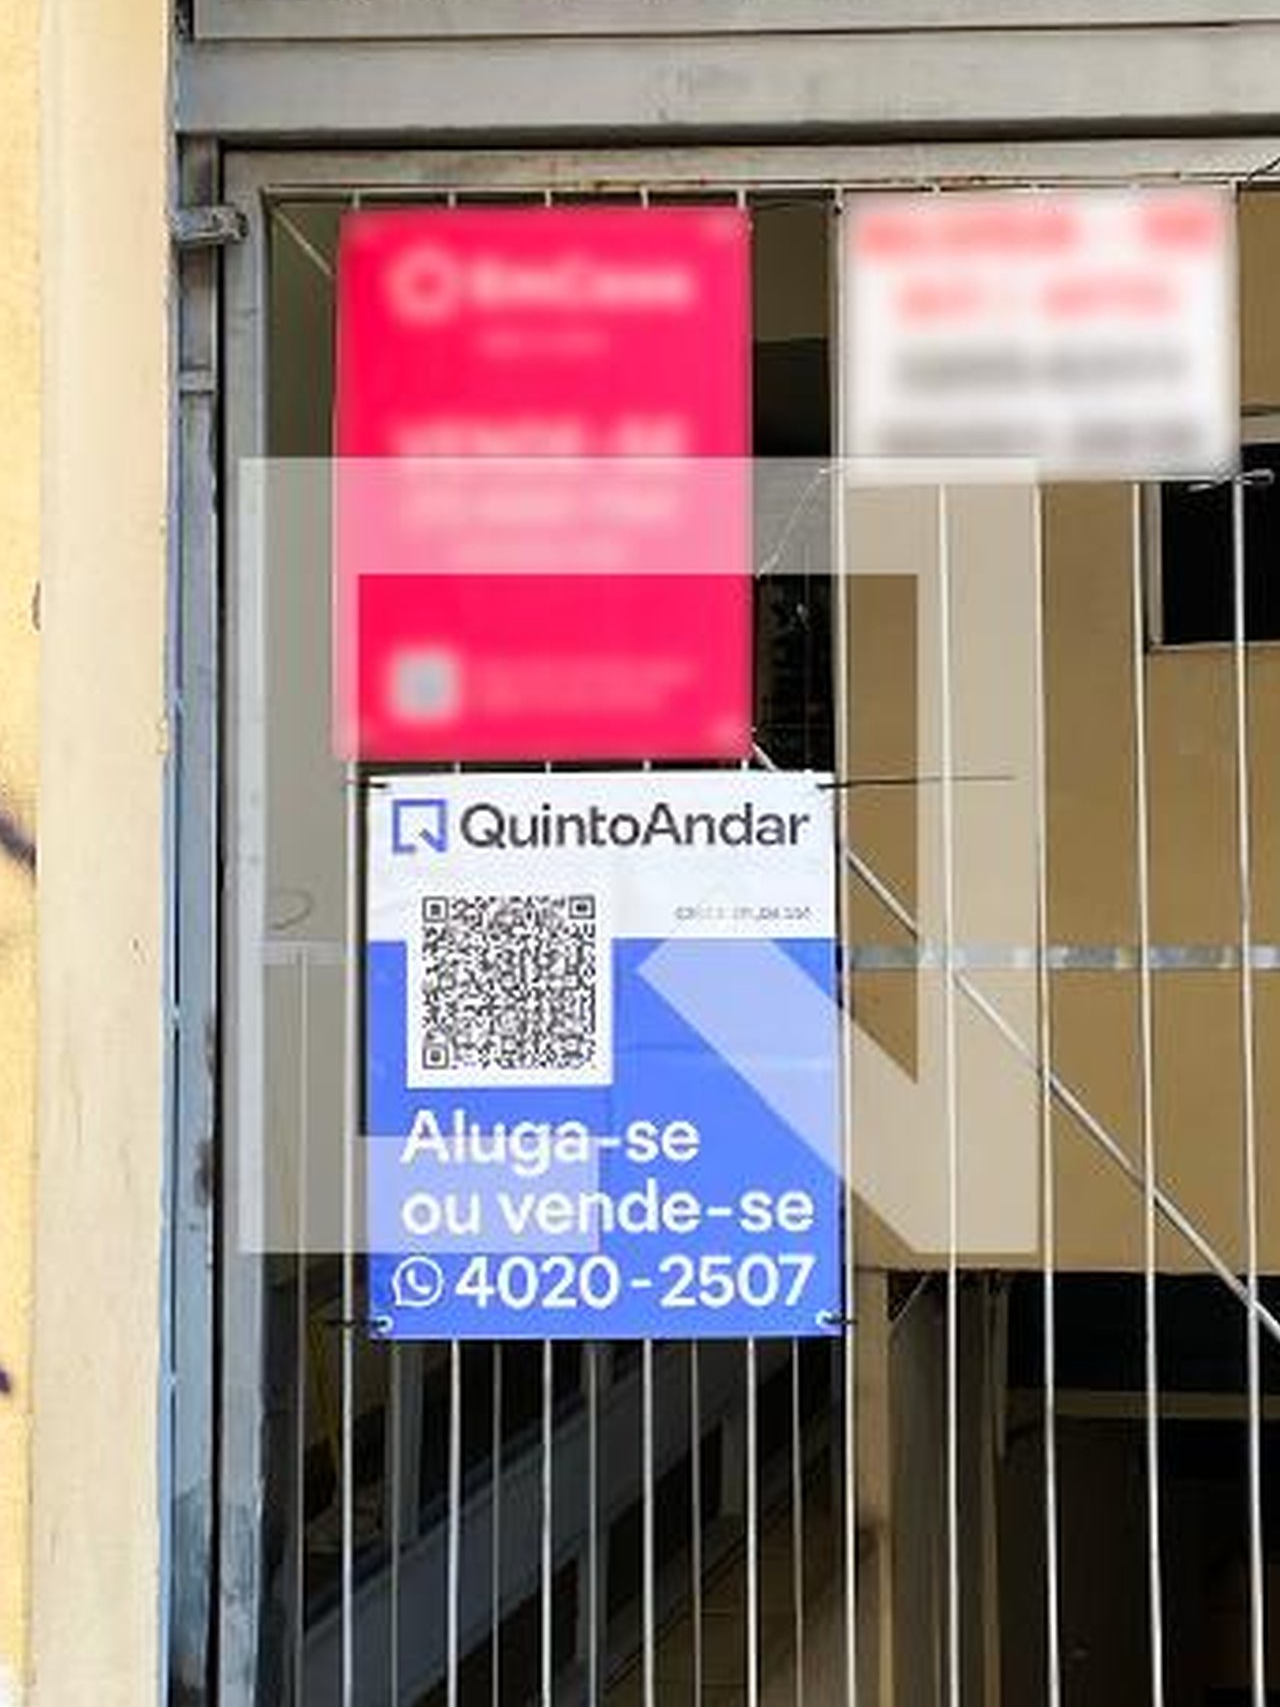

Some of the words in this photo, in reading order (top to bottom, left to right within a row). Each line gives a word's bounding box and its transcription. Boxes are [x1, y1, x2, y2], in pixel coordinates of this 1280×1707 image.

[459, 801, 810, 850] QuintoAndar
[400, 1110, 700, 1175] Aluga-se
[401, 1192, 481, 1234] ou
[499, 1177, 815, 1233] vende-se
[455, 1253, 816, 1310] 4020-2507
